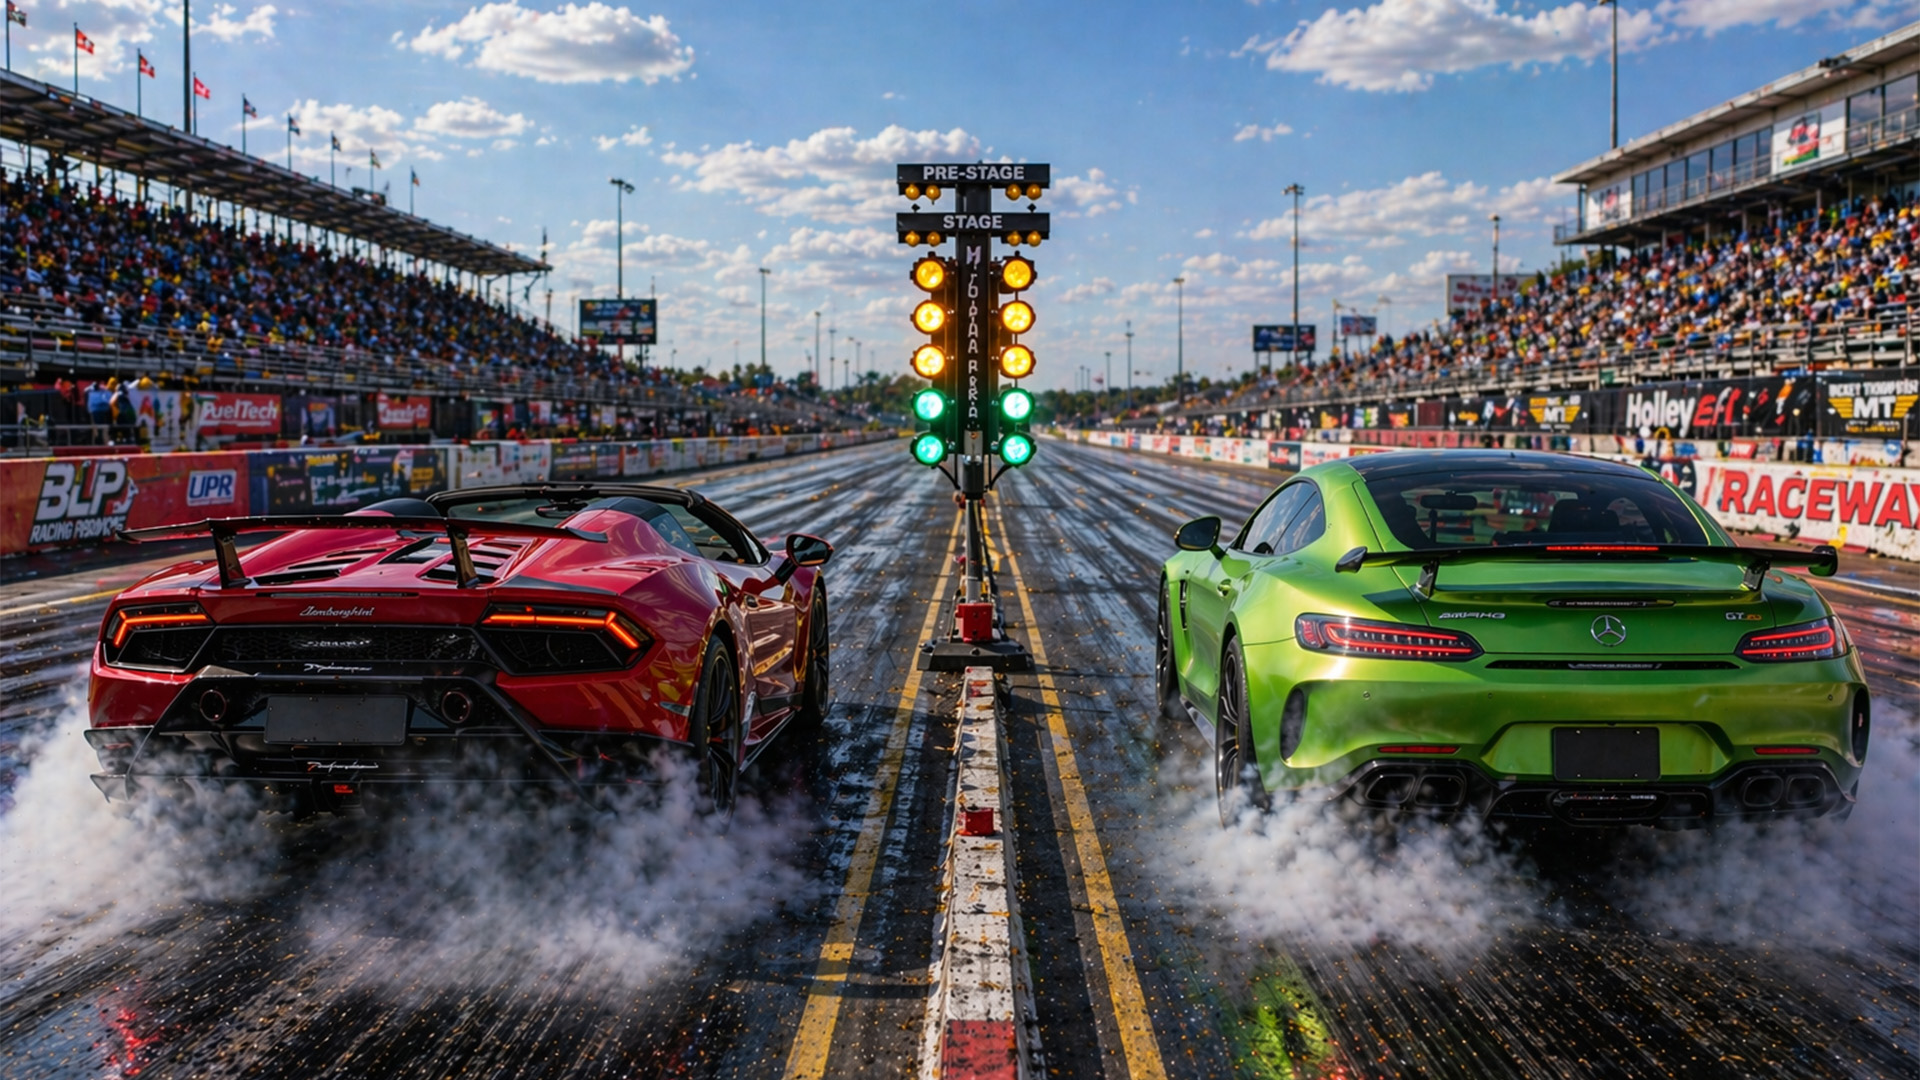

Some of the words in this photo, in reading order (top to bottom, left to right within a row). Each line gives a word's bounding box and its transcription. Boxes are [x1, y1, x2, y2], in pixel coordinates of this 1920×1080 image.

[923, 166, 1025, 180] PRE-STAGE
[943, 214, 1003, 229] STAGE
[1625, 390, 1696, 438] Holley
[1853, 395, 1897, 419] MT
[35, 461, 126, 521] BLP
[189, 474, 233, 498] UPR
[29, 521, 74, 544] RACING
